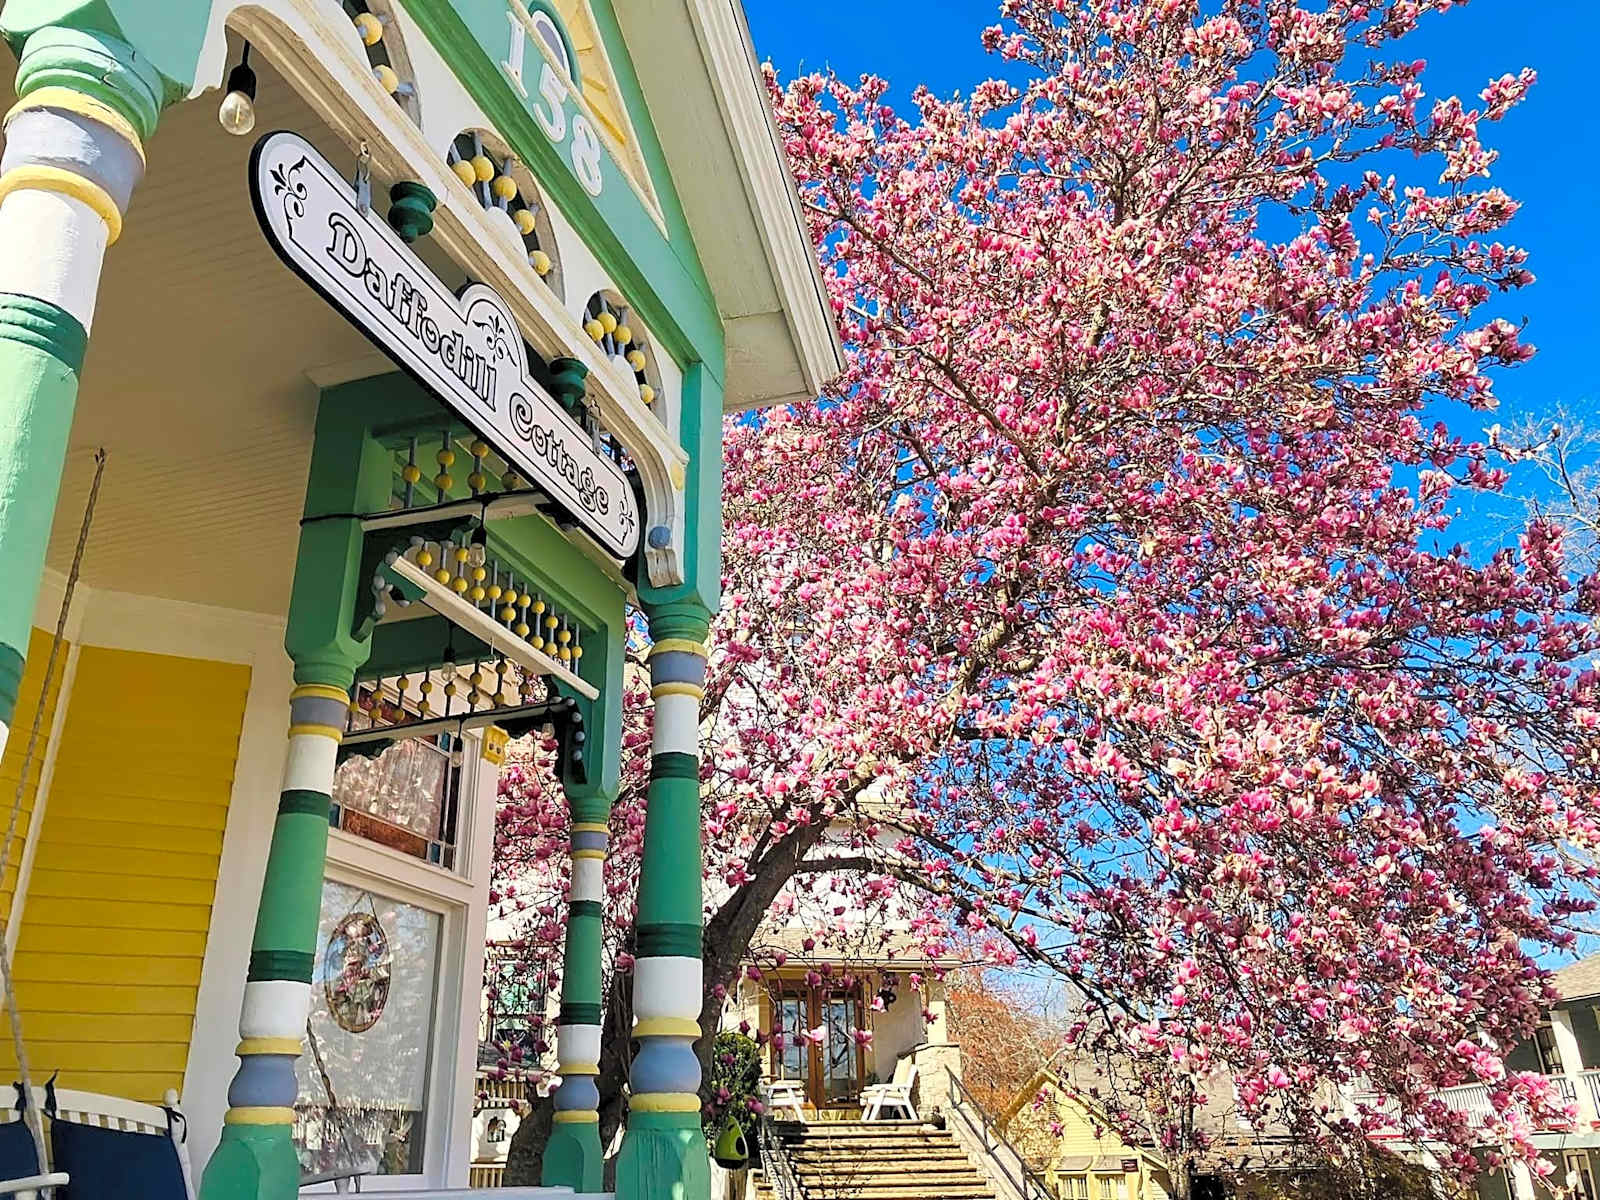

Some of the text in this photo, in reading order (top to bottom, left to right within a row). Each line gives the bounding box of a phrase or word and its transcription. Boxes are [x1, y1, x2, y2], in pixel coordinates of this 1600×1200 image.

[501, 10, 602, 196] 158
[326, 212, 609, 515] Daffodill Cottage
